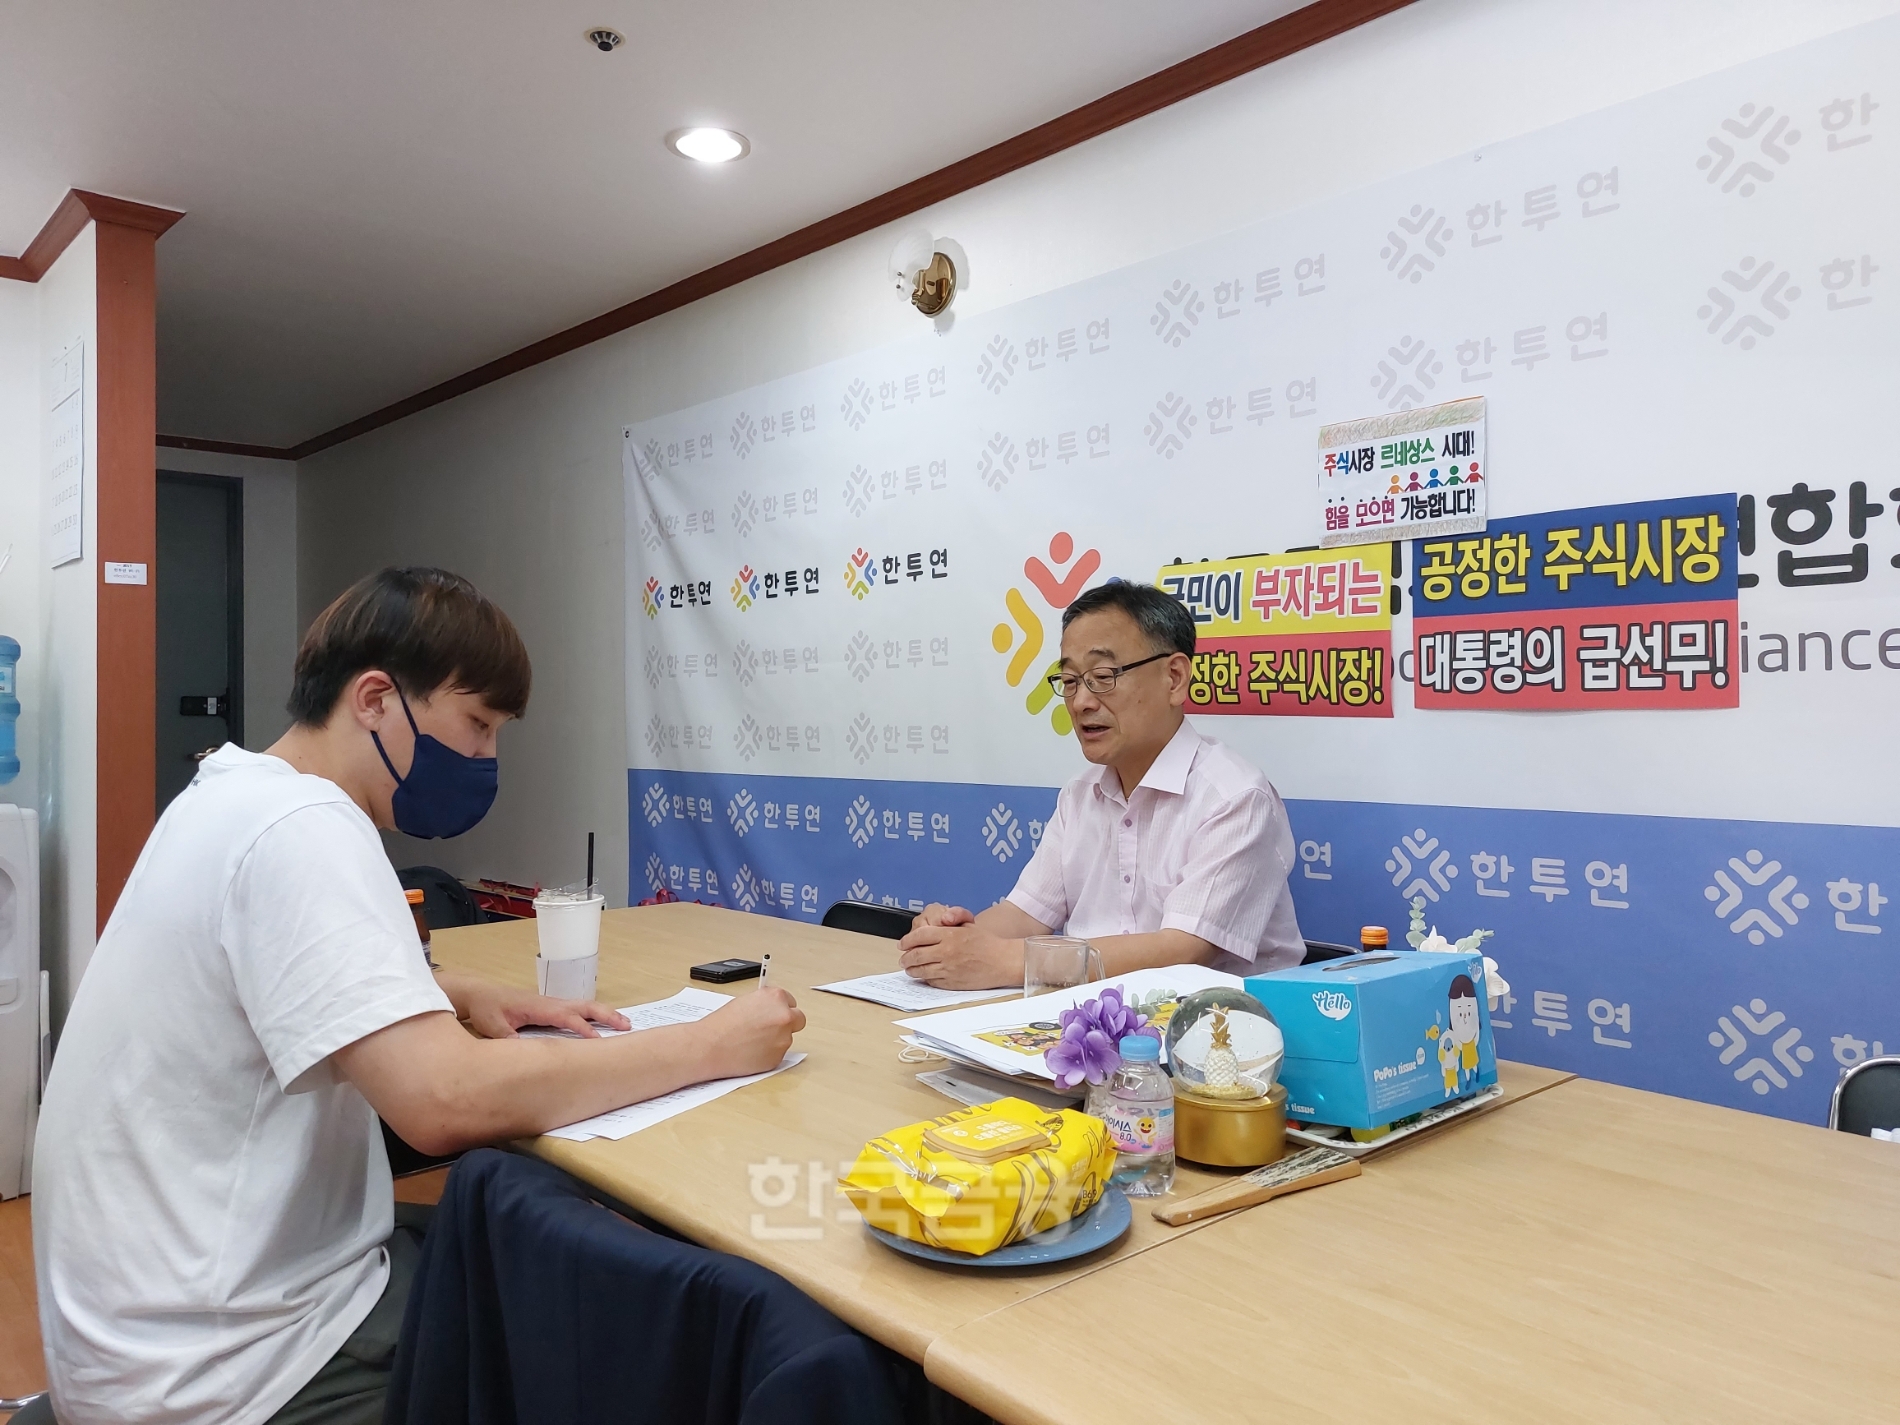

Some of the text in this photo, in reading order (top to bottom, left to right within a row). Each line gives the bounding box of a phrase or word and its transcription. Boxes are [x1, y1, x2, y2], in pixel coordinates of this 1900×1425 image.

[1465, 165, 1621, 248] 한투연
[1213, 253, 1326, 320] 한투연
[1025, 317, 1110, 372] 한투연
[1455, 312, 1609, 384] 한투연
[879, 365, 946, 412] 한투연
[1205, 376, 1317, 435] 한투연
[760, 403, 816, 443] 한투연
[667, 432, 713, 467] 한투연
[1025, 422, 1111, 471] 한투연
[1324, 430, 1475, 477] 주식시장 르네상스 시대!
[881, 458, 947, 500] 한투연
[763, 487, 818, 522] 한투연
[1325, 488, 1476, 531] 힘을 모으면 가능합니다!
[664, 508, 715, 540] 한투연
[882, 548, 948, 585] 한투연
[1420, 514, 1725, 600] 공정한 주식시장
[669, 580, 712, 609] 한투연
[764, 567, 819, 599] 한투연
[1252, 561, 1382, 620] 부자되는
[666, 652, 718, 678] 한투연
[762, 646, 819, 675] 한투연
[882, 637, 949, 669] 한투연
[1419, 624, 1565, 692] 대통령의
[1578, 619, 1729, 691] 급선무!
[1741, 621, 1900, 674] iance
[1189, 650, 1241, 704] 정한
[1249, 649, 1384, 705] 주식시장!
[668, 724, 713, 749] 한투연
[766, 725, 821, 752] 한투연
[883, 724, 949, 755] 한투연
[672, 793, 713, 823] 한투연
[764, 801, 821, 833] 한투연
[883, 809, 950, 844] 한투연
[669, 864, 719, 895] 한투연
[760, 877, 818, 914] 한투연
[1470, 850, 1630, 910] 한투연
[1398, 1061, 1416, 1074] tissue
[1291, 1104, 1315, 1114] tissue
